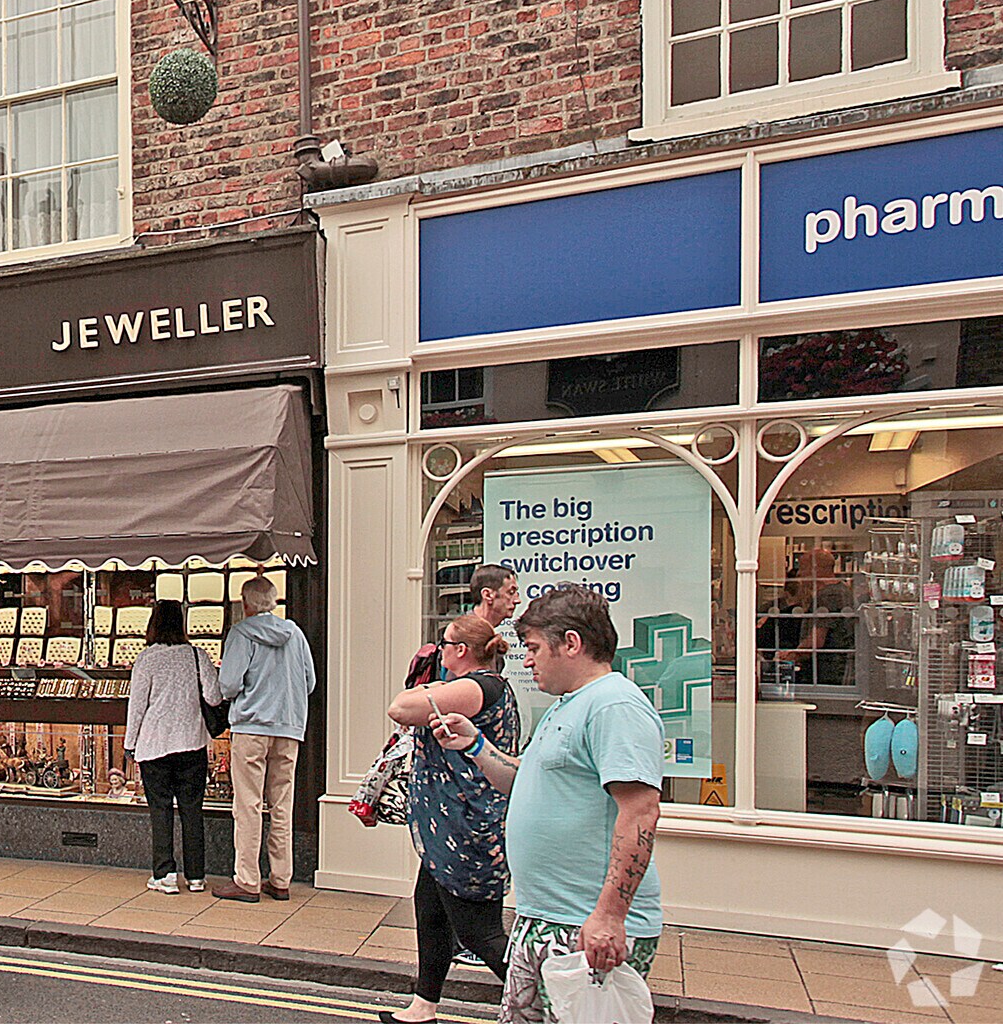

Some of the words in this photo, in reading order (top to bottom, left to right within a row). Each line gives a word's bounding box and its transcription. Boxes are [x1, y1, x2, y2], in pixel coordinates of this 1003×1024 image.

[51, 295, 275, 352] JEWELLER
[499, 500, 546, 520] The
[553, 496, 592, 521] big
[764, 498, 912, 529] rescriptio
[500, 521, 654, 551] prescription
[500, 551, 636, 573] switchover
[527, 578, 621, 602] coing
